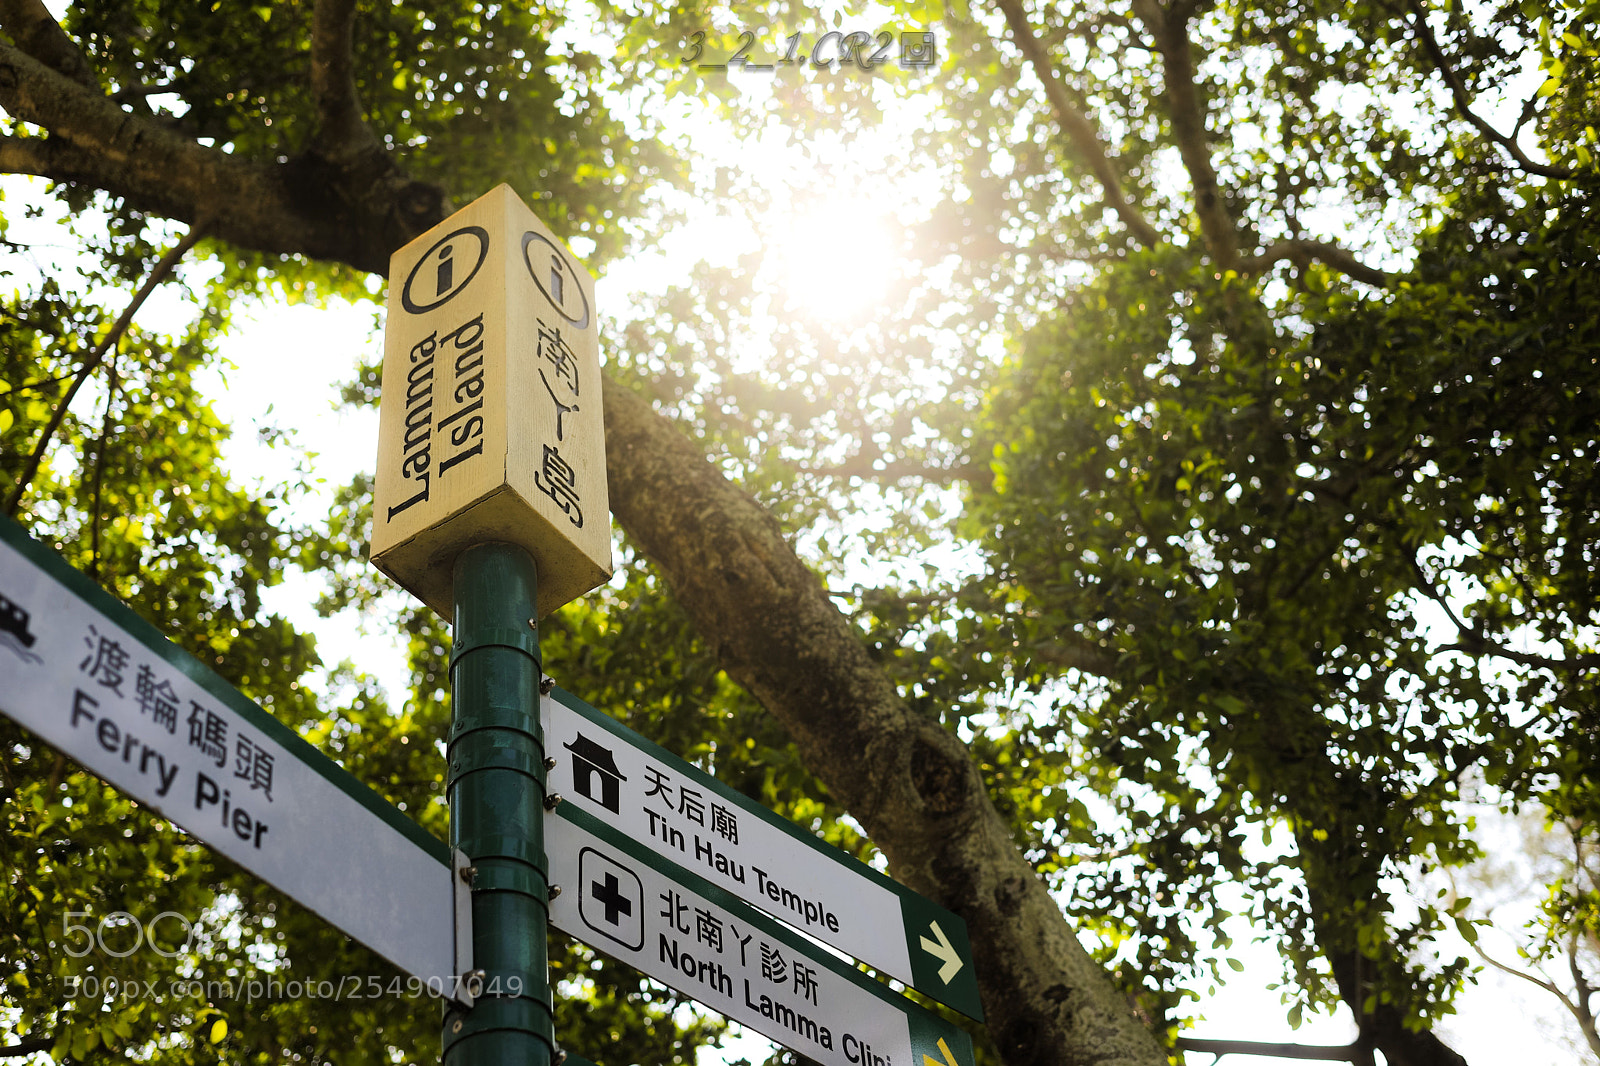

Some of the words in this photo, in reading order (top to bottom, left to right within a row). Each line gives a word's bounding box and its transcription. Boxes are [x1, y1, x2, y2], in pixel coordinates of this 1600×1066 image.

[387, 331, 437, 523] Lamma
[437, 313, 484, 478] Island
[534, 317, 583, 529] 南丫島
[71, 688, 179, 797] Ferry
[195, 771, 268, 849] Pier
[79, 624, 275, 803] 渡輪碼頭
[643, 806, 685, 852] Tin
[694, 834, 745, 884] Hau
[752, 866, 839, 933] Temple
[644, 765, 739, 845] 天后廟
[659, 889, 819, 1007] 北南丫診所
[659, 933, 733, 998] North
[744, 979, 834, 1051] Lamma
